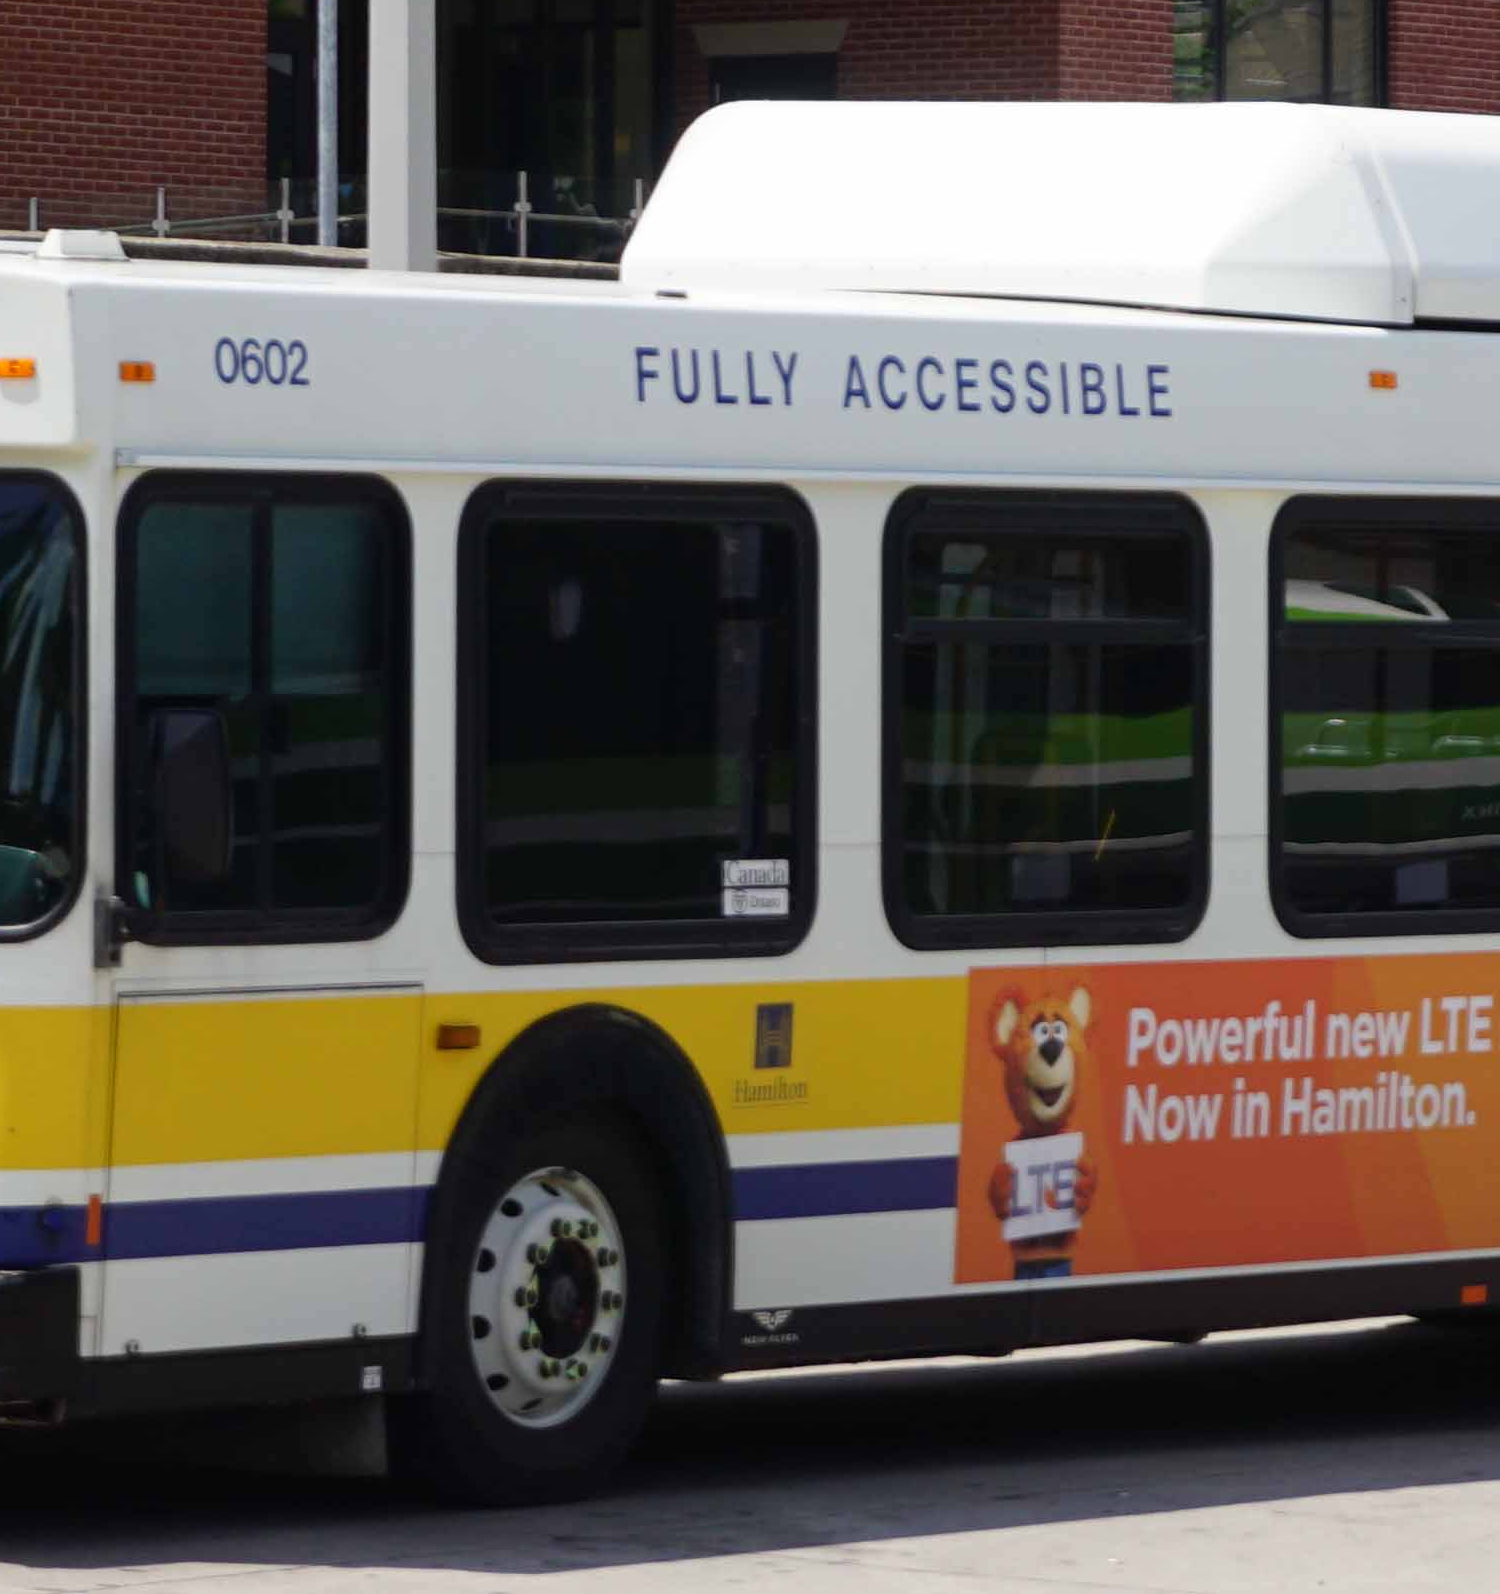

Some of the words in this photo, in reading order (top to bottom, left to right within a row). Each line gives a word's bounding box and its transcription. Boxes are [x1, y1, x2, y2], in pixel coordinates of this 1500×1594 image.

[213, 337, 310, 388] 0602
[634, 346, 800, 407] FULLY
[843, 355, 1174, 418] ACCESSIBLE
[725, 859, 788, 886] Canada
[1126, 1000, 1316, 1067] Powerful
[1327, 1009, 1407, 1059] new
[1419, 995, 1493, 1054] LTE
[733, 1074, 808, 1103] Hamilton
[1122, 1083, 1223, 1144] Now
[1232, 1079, 1268, 1135] in
[1280, 1073, 1477, 1136] Hamilton.
[1010, 1159, 1077, 1218] LTE
